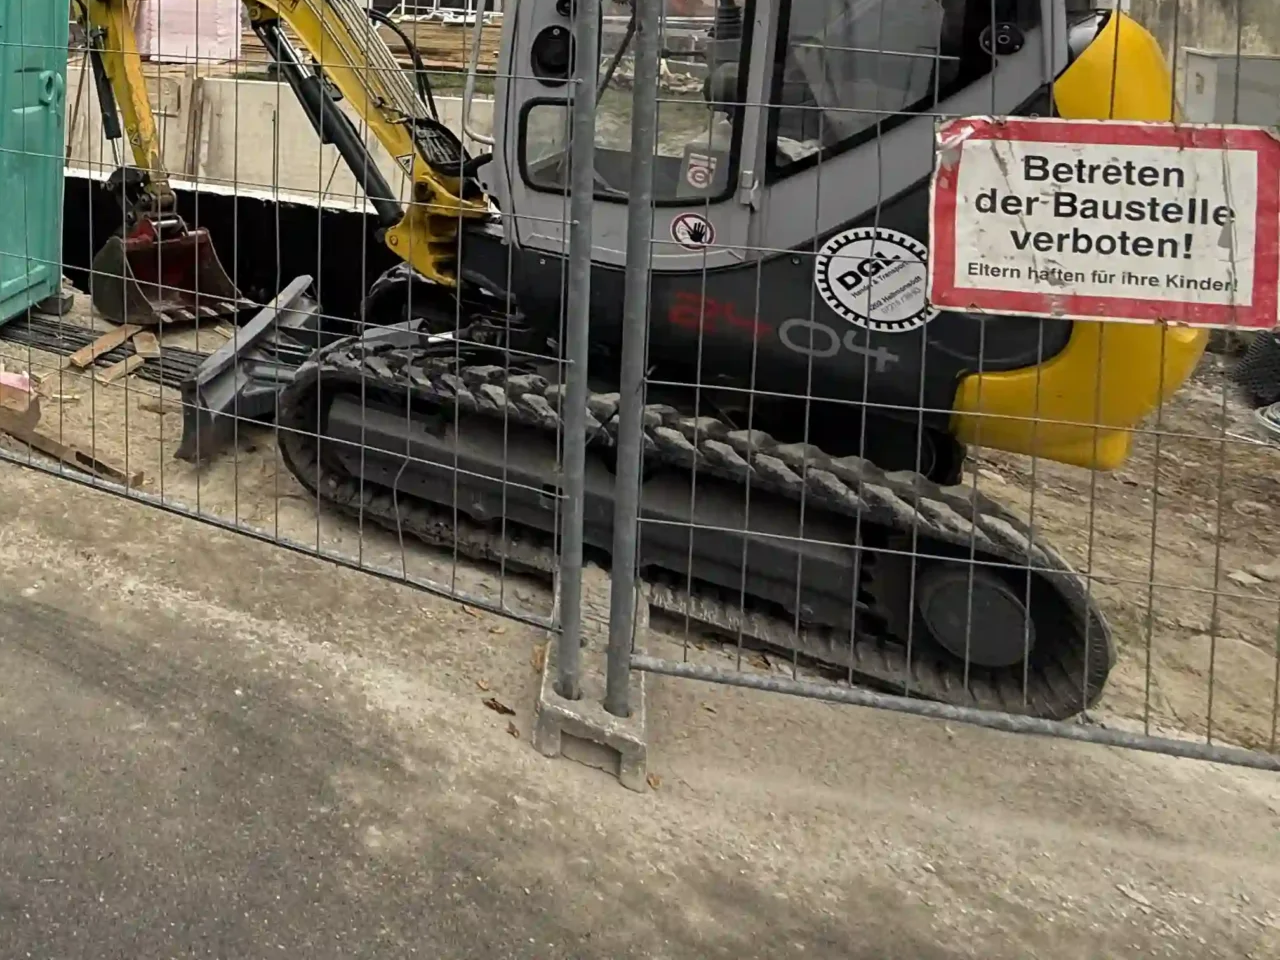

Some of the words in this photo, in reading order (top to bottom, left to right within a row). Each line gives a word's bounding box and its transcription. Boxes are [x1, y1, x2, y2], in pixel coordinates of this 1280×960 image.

[1023, 155, 1184, 187] Betreten
[975, 188, 1040, 216] der
[1053, 191, 1235, 227] Baustelle
[1010, 227, 1193, 259] verboten!
[835, 251, 901, 291] DGL
[968, 262, 1021, 280] Eltern
[1027, 266, 1085, 284] haften
[1091, 269, 1116, 285] für
[1121, 271, 1160, 287] ihre
[1166, 274, 1238, 292] Kinder!
